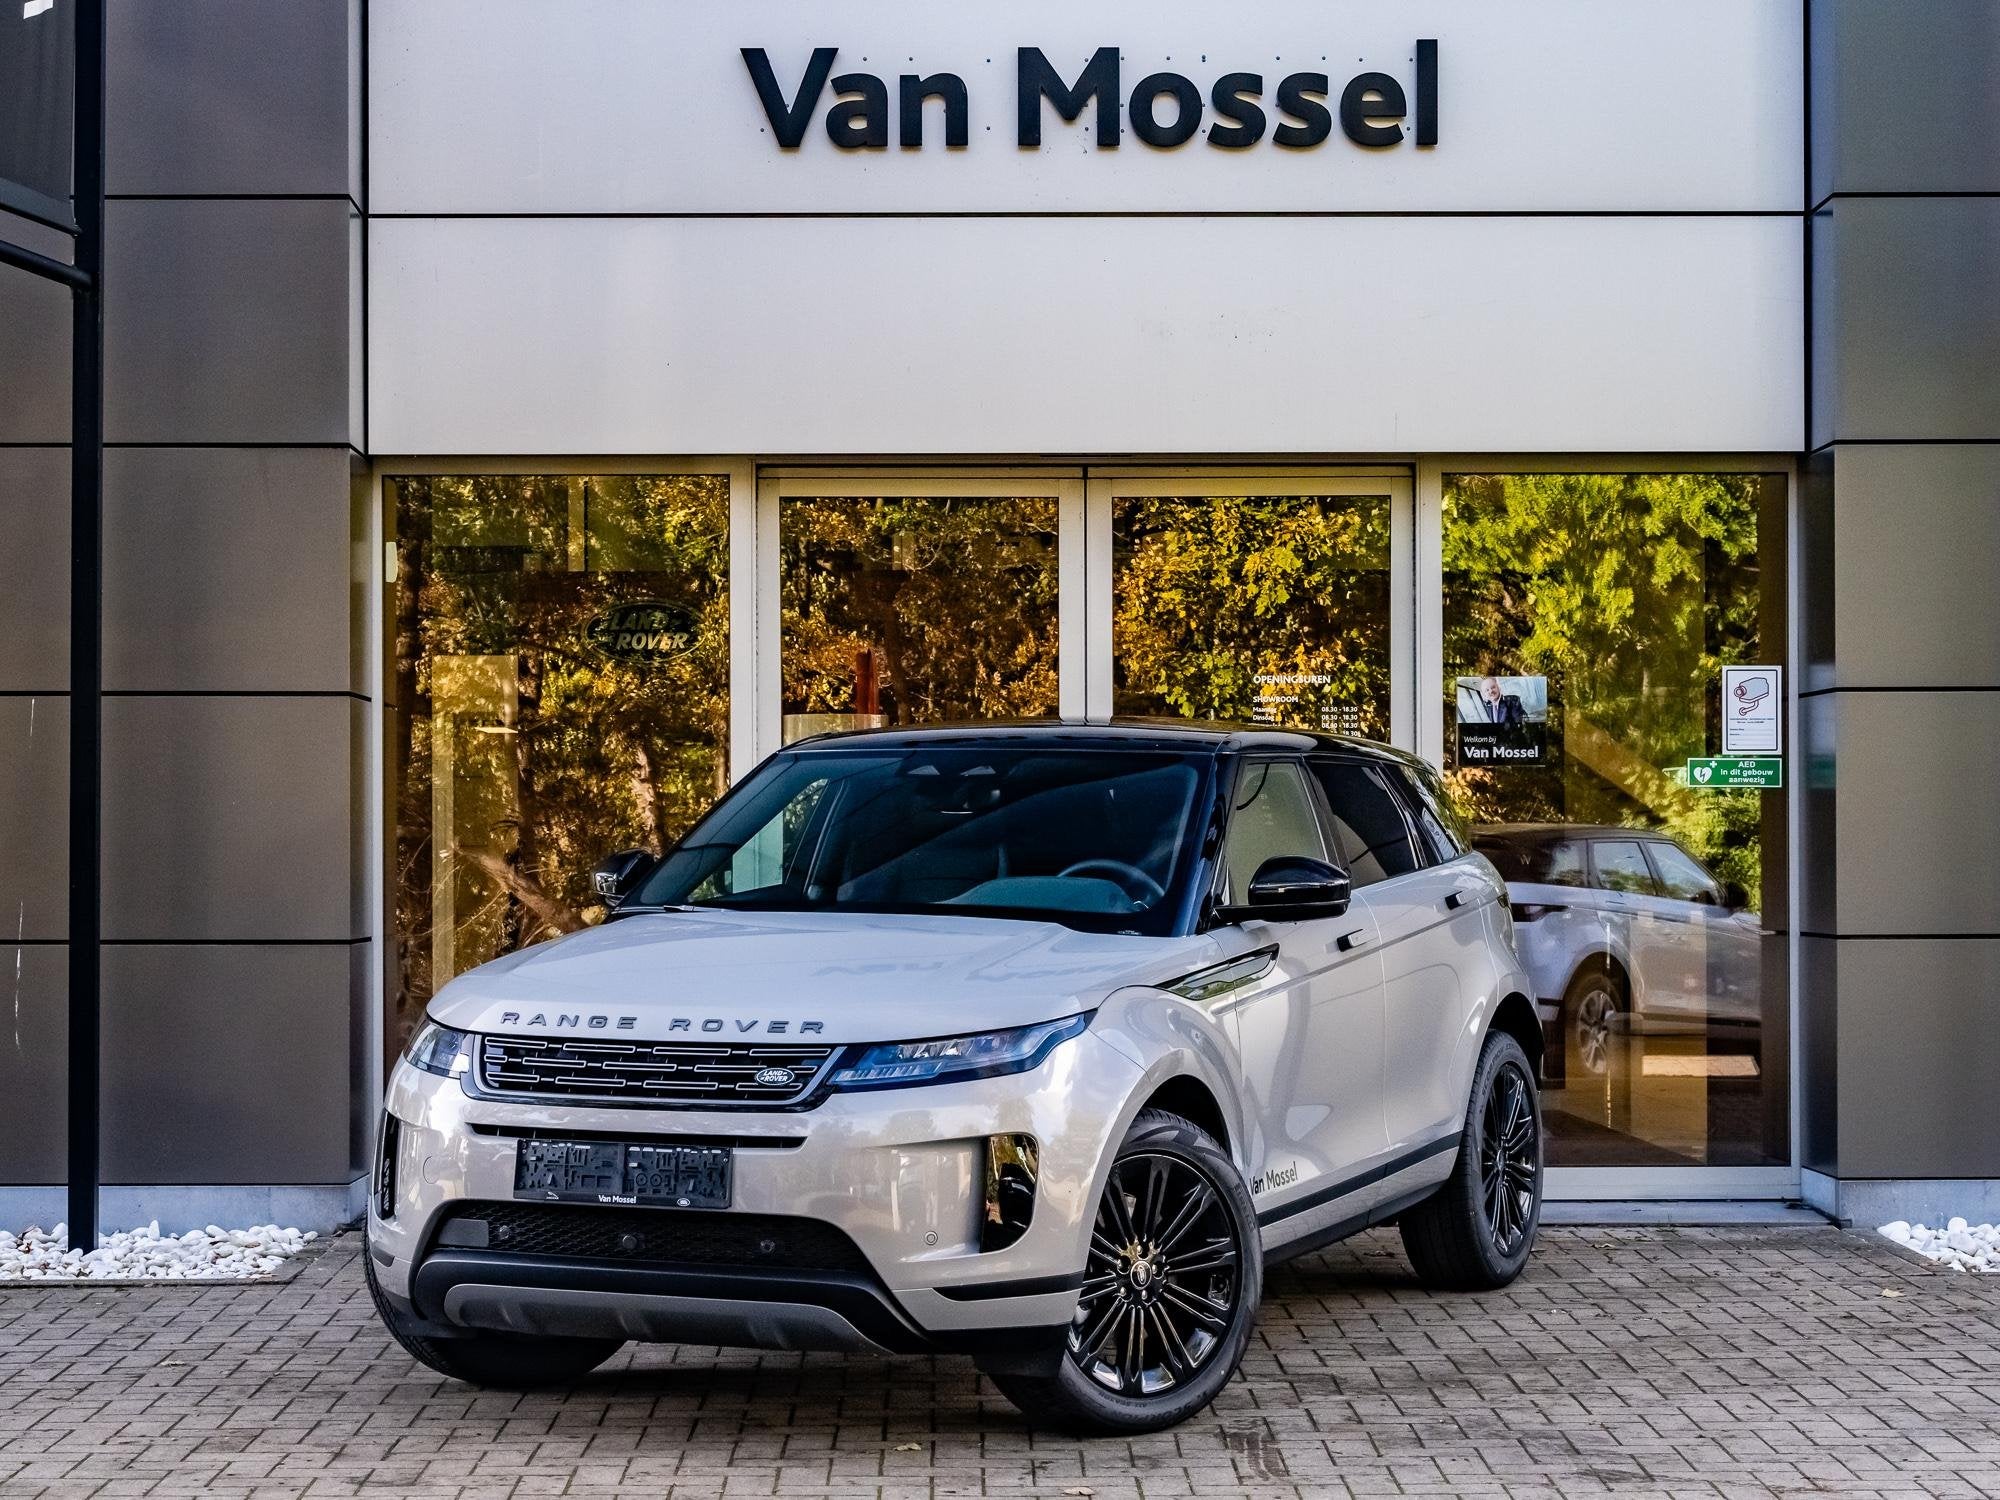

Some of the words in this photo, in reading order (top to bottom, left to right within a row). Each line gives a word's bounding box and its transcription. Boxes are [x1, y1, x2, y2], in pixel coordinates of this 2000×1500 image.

[740, 46, 968, 147] Van
[1017, 38, 1438, 148] Mossel
[616, 631, 690, 651] ROVER
[1252, 675, 1331, 684] OPENINGSUREN
[1252, 695, 1299, 703] SHOWROOM
[1463, 735, 1488, 743] Welkom
[1488, 735, 1497, 744] bij
[1463, 746, 1489, 758] Van
[1492, 745, 1539, 758] Mossel
[1730, 768, 1740, 776] dit
[1742, 768, 1774, 777] gebouw
[1728, 776, 1766, 784] aanwezig
[500, 1011, 638, 1029] RANGE
[668, 1017, 825, 1035] ROVER
[1249, 1175, 1265, 1197] Van
[1265, 1160, 1299, 1191] Mossel
[598, 1194, 611, 1203] Van
[612, 1195, 637, 1204] Mossel
